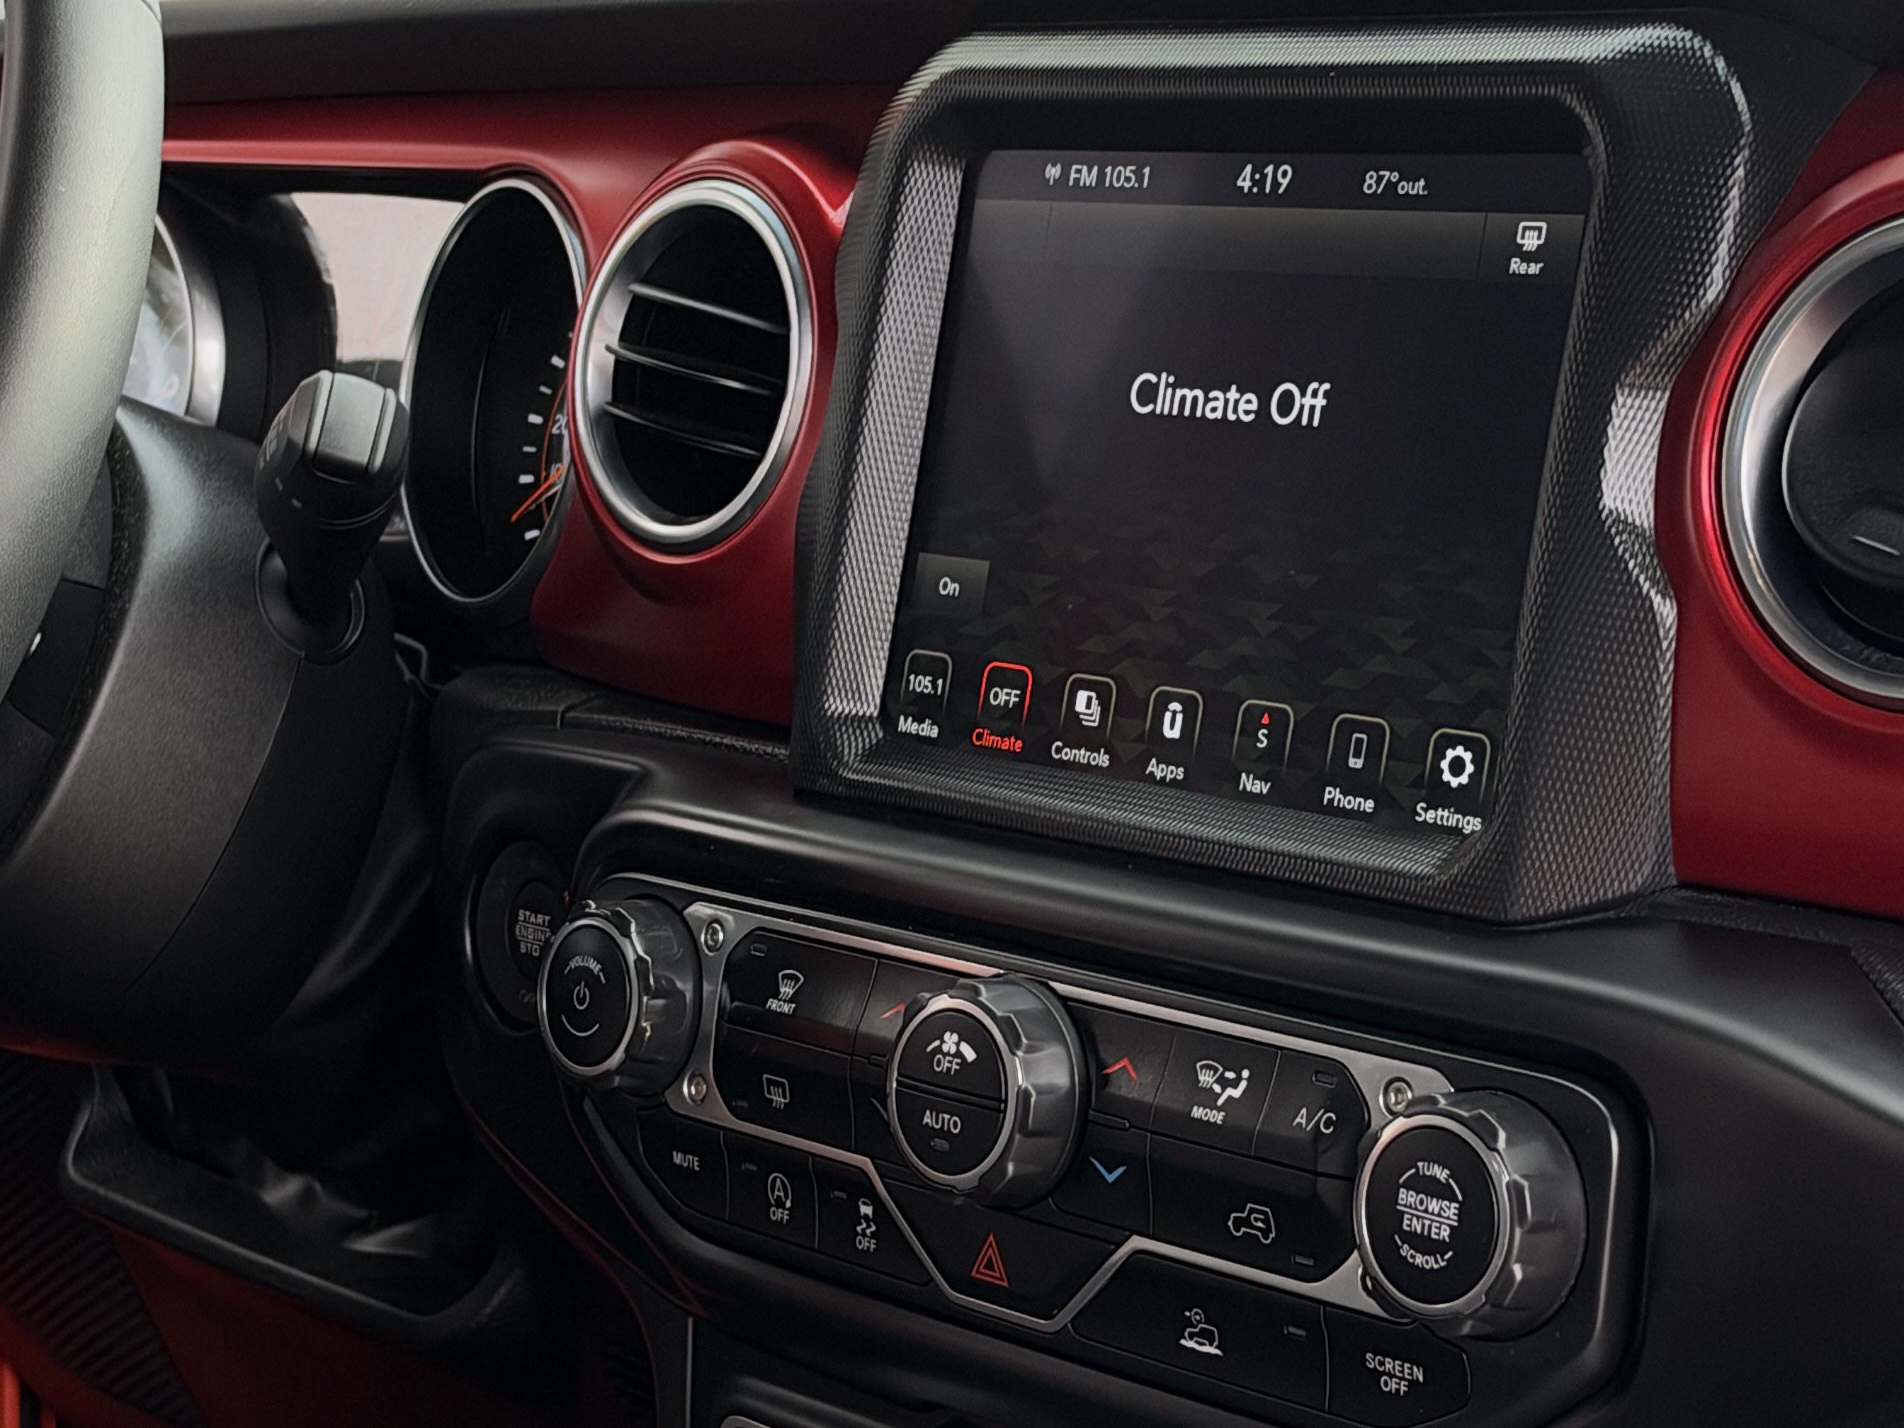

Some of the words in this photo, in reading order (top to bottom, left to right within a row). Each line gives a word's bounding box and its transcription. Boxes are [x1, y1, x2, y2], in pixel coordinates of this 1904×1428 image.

[1069, 164, 1098, 187] FM
[1104, 165, 1151, 188] 105.1
[1236, 163, 1293, 194] 4:19
[1509, 257, 1545, 275] Rear
[1130, 371, 1258, 422] Climate
[1270, 381, 1332, 427] Off
[938, 576, 960, 597] On
[908, 673, 944, 696] 105.1
[989, 687, 1021, 708] OFF
[1256, 728, 1270, 748] S
[897, 714, 939, 738] Media
[972, 728, 1023, 752] Climate
[1051, 741, 1110, 768] Controls
[1145, 757, 1185, 783] Apps
[1239, 772, 1272, 796] Nav
[1323, 786, 1375, 813] Phone
[1415, 802, 1483, 834] Settings
[517, 909, 551, 927] START
[520, 941, 540, 957] STO
[569, 955, 603, 976] VOLUME
[766, 999, 796, 1015] FRONT
[932, 1054, 962, 1077] OFF
[922, 1109, 962, 1134] AUTO
[1191, 1105, 1226, 1125] MODE
[1293, 1107, 1337, 1136] A/C
[672, 1150, 700, 1171] MUTE
[1416, 1160, 1451, 1184] TUNE
[770, 1206, 790, 1224] OFF
[1397, 1187, 1460, 1221] BROWSE
[1402, 1213, 1451, 1243] ENTER
[855, 1235, 877, 1252] OFF
[1399, 1243, 1447, 1270] SCROLL
[1365, 1352, 1424, 1383] SCREEN
[1380, 1375, 1409, 1396] OFF
